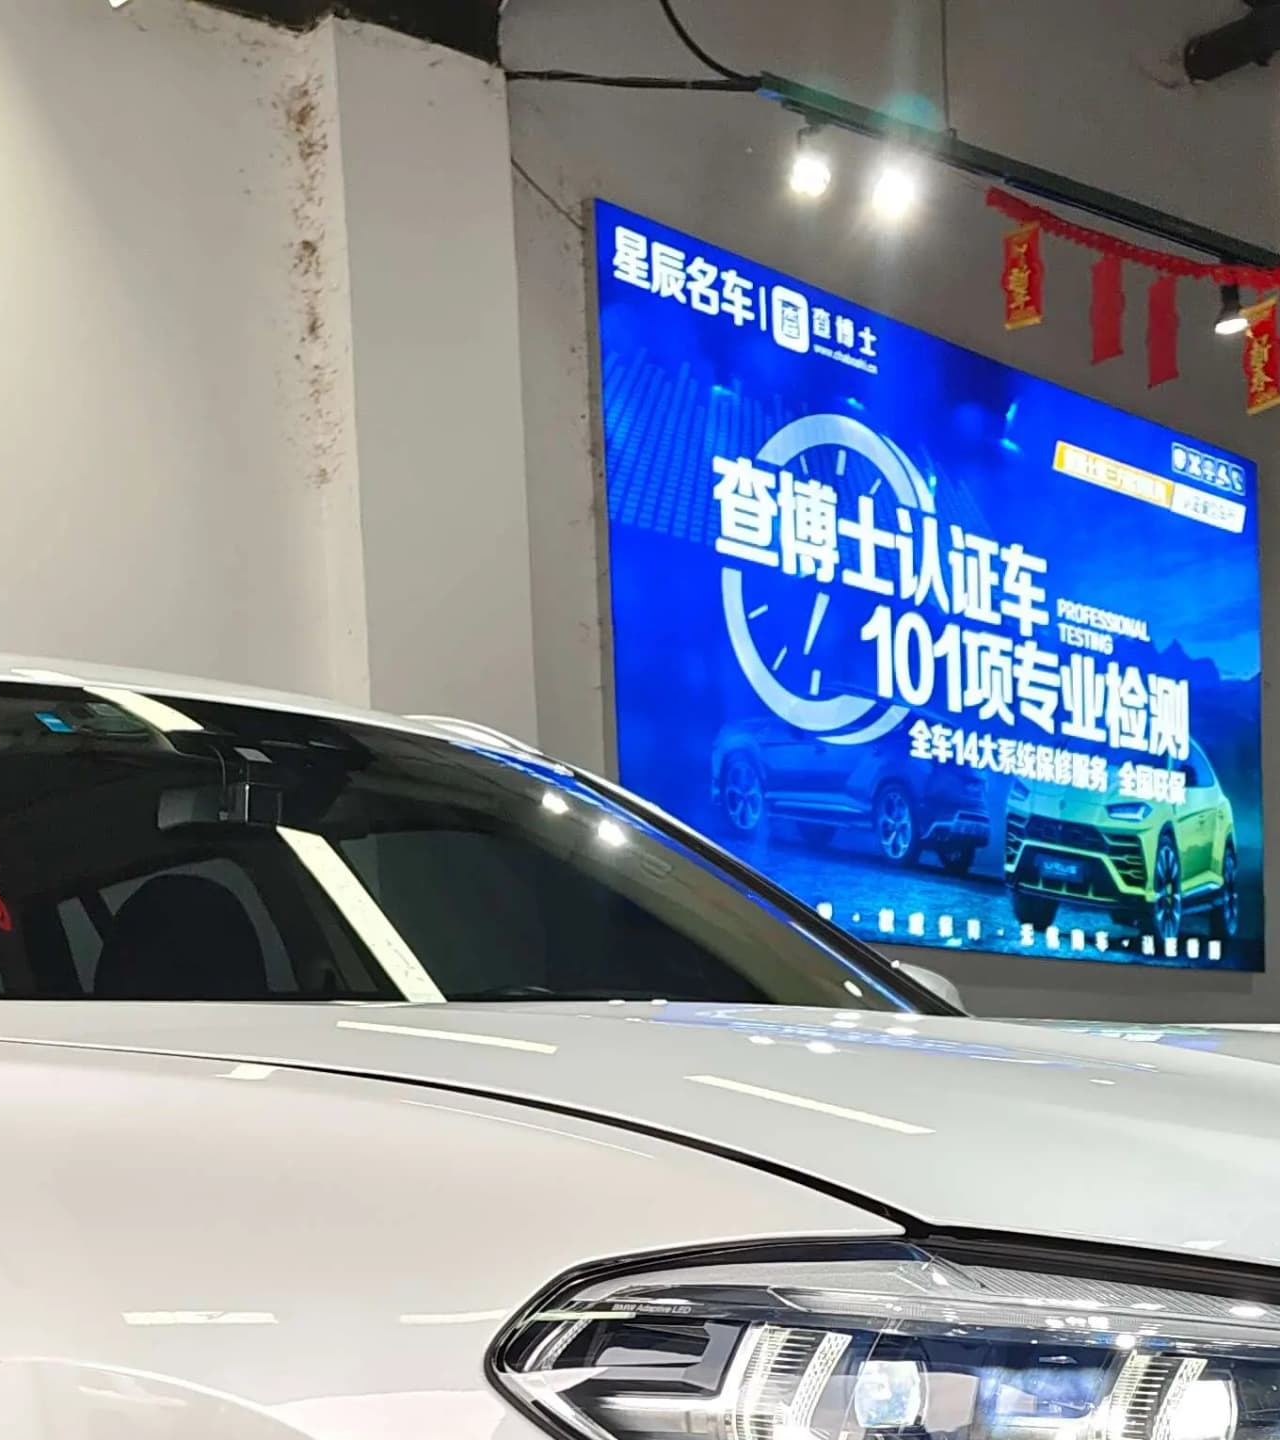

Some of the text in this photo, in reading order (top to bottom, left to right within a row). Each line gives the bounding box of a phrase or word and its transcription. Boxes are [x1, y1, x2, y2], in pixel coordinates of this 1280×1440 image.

[613, 226, 755, 327] 星辰名车
[713, 455, 1050, 637] 查博士认证车
[1056, 597, 1151, 643] PROFESSIONAL
[1057, 622, 1114, 656] TESTING
[860, 603, 1190, 761] 101项专业检测
